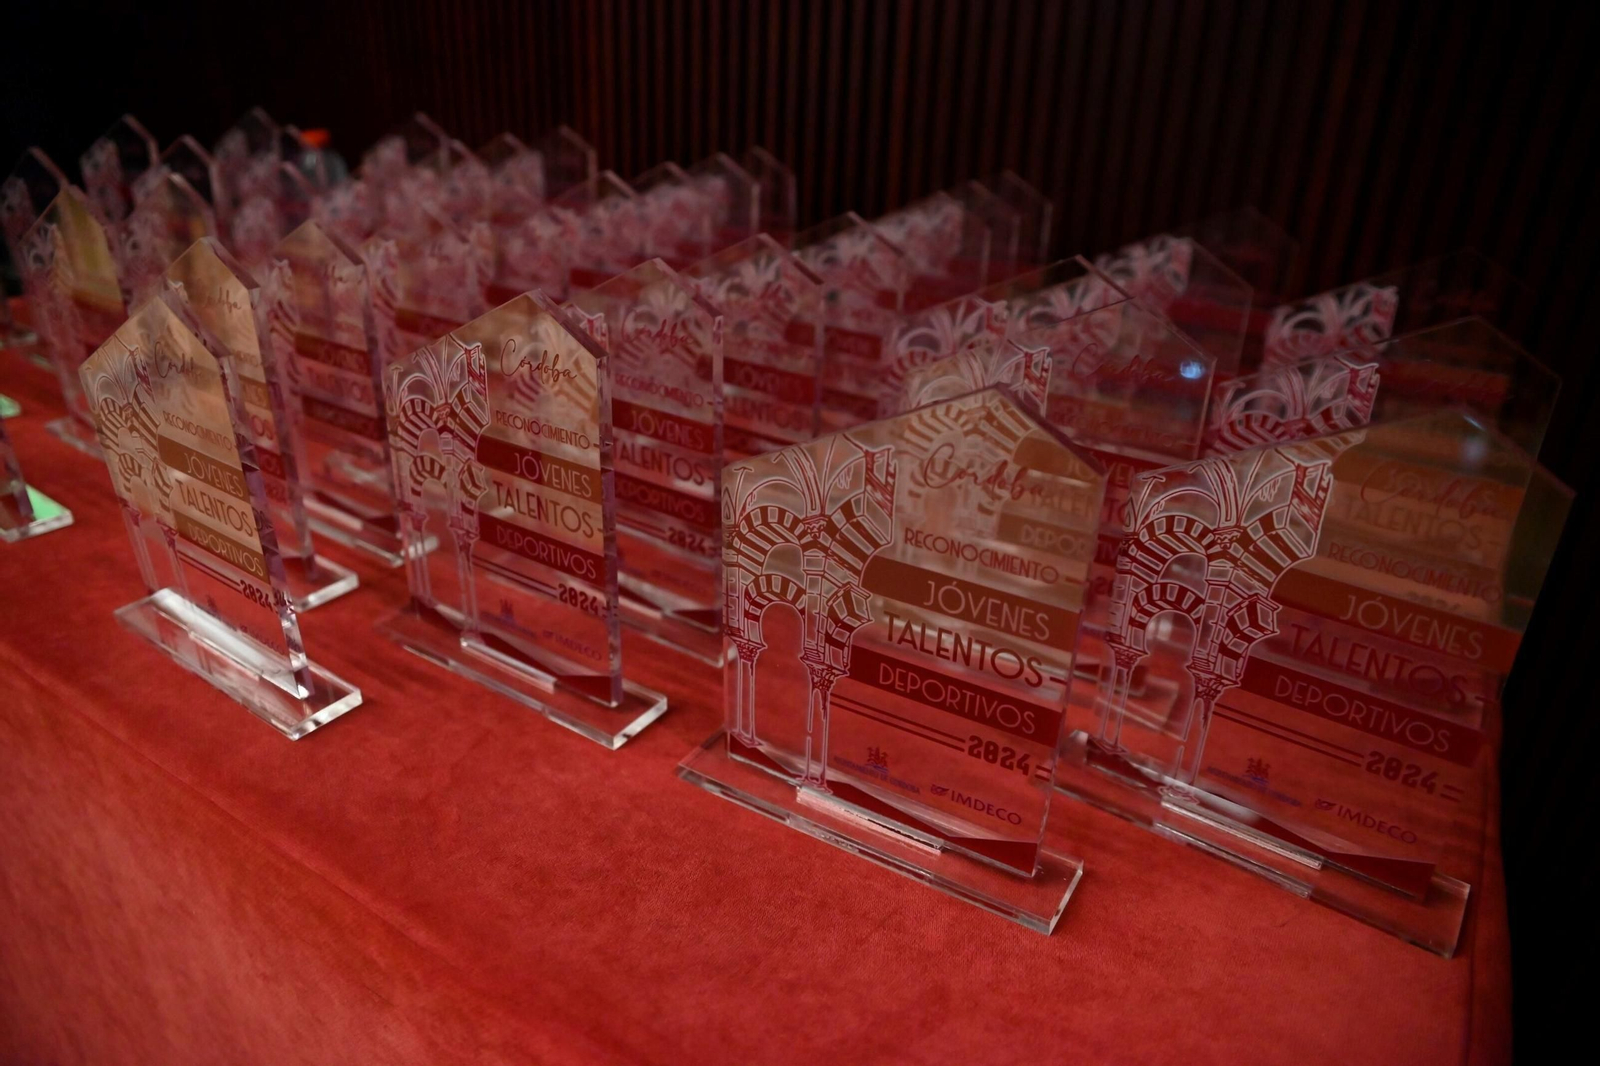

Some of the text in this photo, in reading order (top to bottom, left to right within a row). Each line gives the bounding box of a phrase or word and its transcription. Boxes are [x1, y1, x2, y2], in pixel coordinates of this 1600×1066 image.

[500, 338, 577, 384] Córdoba
[496, 410, 591, 449] RECONOCIMIENTO
[630, 409, 704, 449] JÓVENES
[184, 452, 243, 498] JÓVENES
[513, 451, 592, 498] JÓVENES
[175, 479, 254, 538] TALENTOS
[493, 480, 594, 538] TALENTOS
[187, 522, 264, 577] DEPORTIVOS
[496, 525, 597, 579] DEPORTIVOS
[666, 527, 706, 556] 2024
[905, 527, 1060, 585] RECONOCIMIENTO
[239, 579, 274, 613] 2024
[1328, 542, 1501, 603] RECONOCIMIENTO
[558, 583, 599, 616] 2024
[923, 581, 1050, 641] JÓVENES
[884, 610, 1043, 688] TALENTOS
[1339, 595, 1483, 660] JÓVENES
[1291, 623, 1468, 705] TALENTOS
[879, 662, 1036, 735] DEPORTIVOS
[1274, 675, 1451, 753] DEPORTIVOS
[967, 735, 1031, 776] 2024
[1365, 750, 1440, 794] 2024
[951, 790, 1022, 825] IMDECO
[1337, 804, 1418, 844] IMDECO
